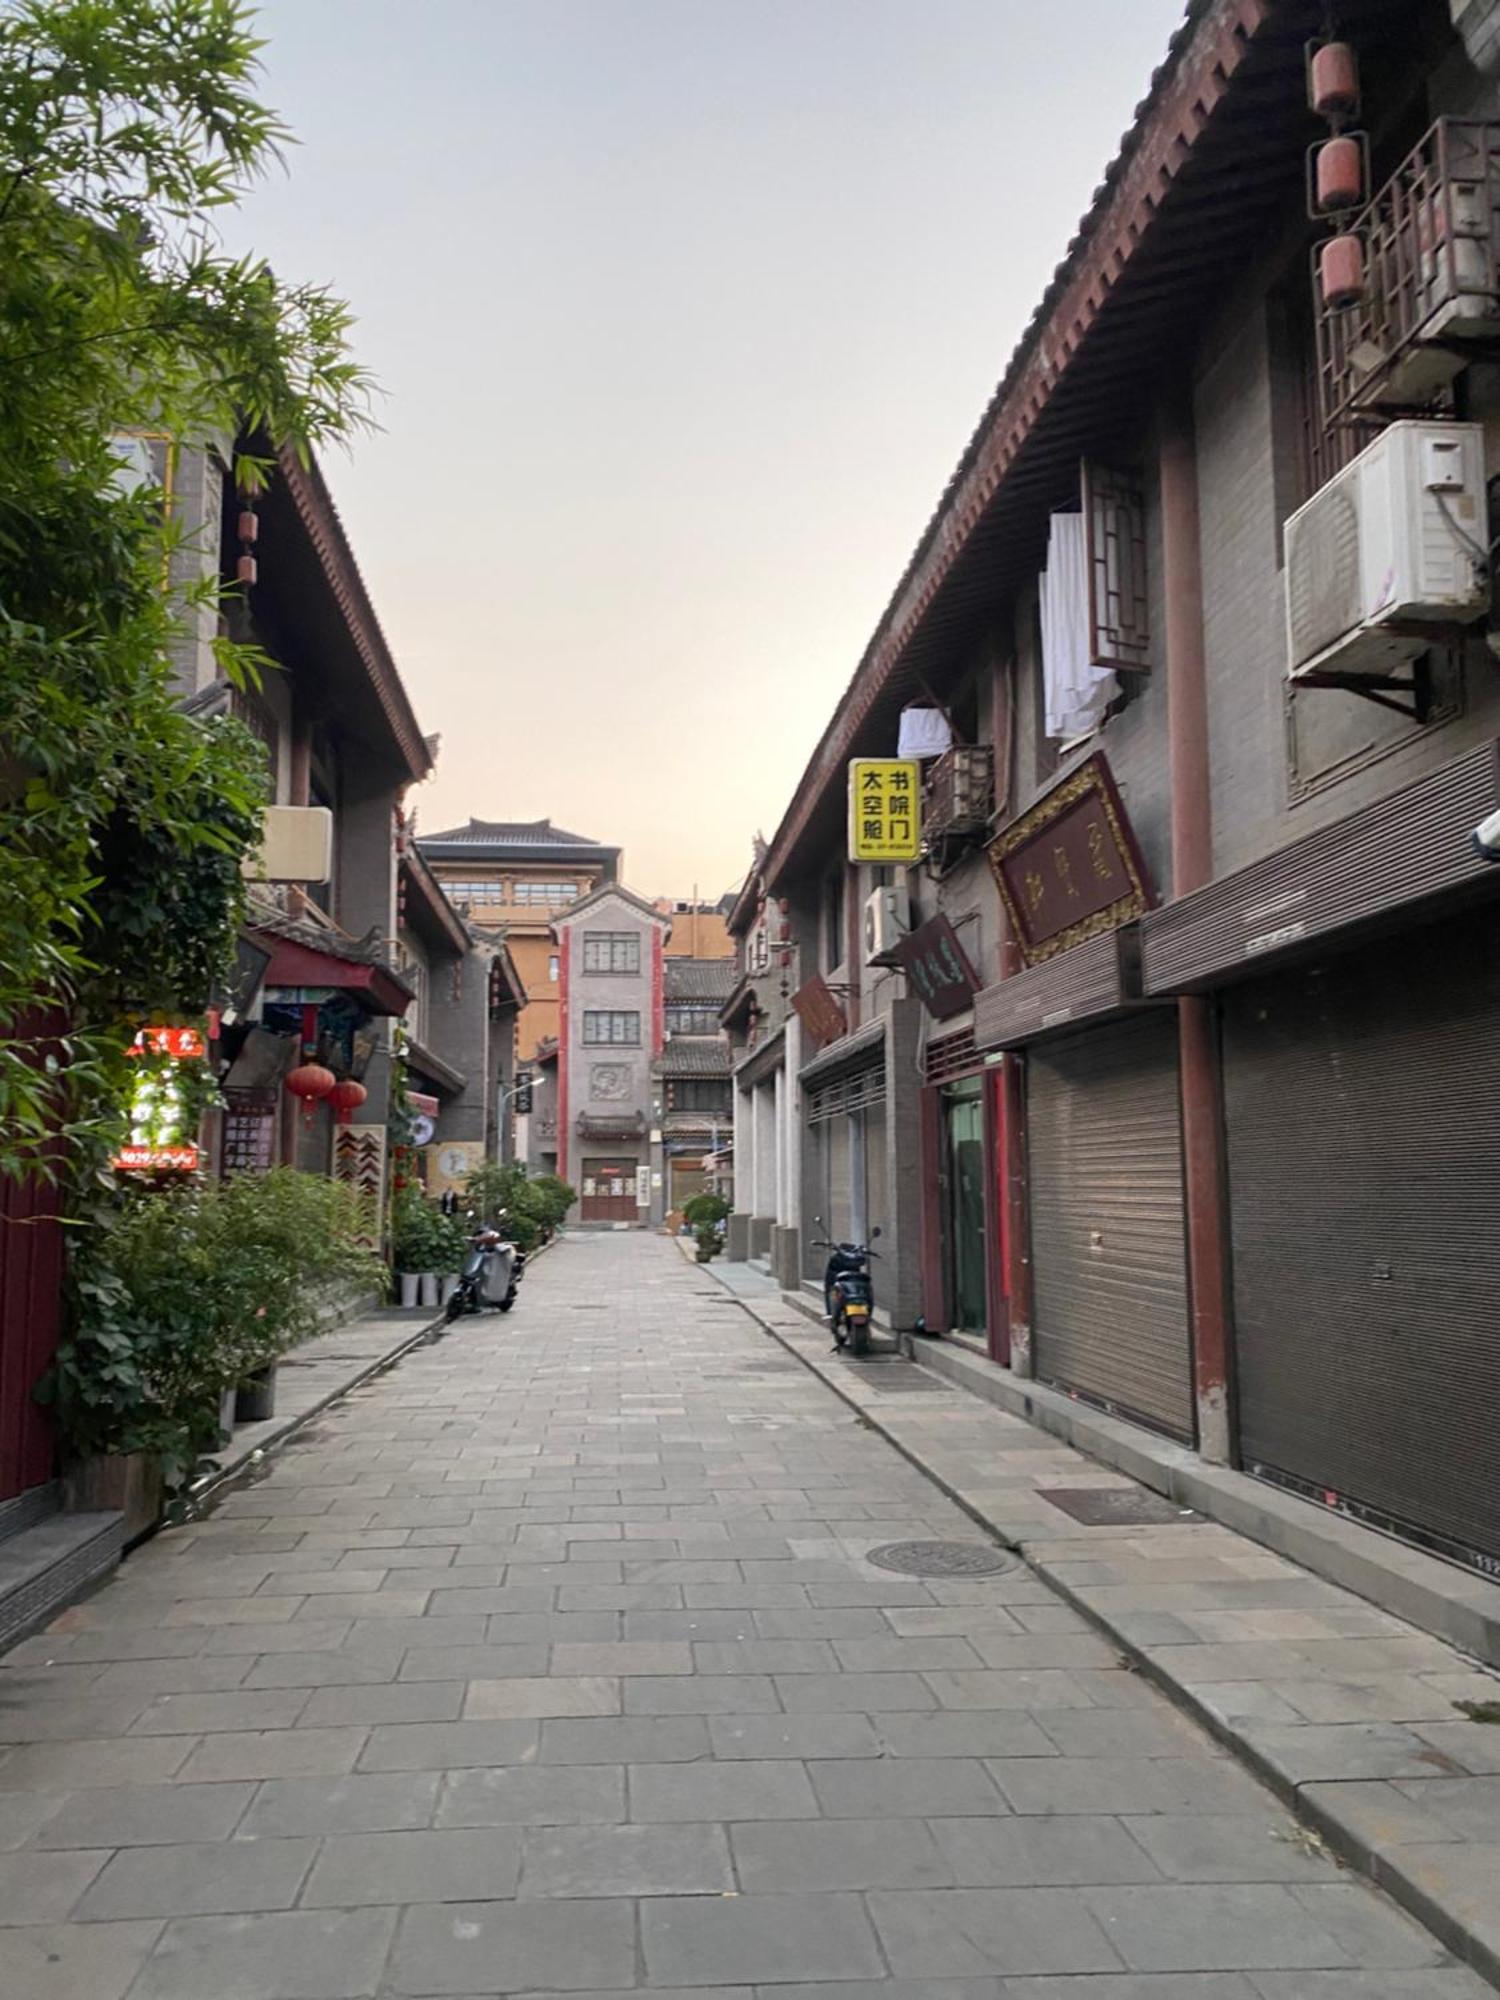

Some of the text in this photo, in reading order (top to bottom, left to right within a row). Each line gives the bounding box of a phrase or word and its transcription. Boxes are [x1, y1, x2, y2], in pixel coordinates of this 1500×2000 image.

[862, 771, 882, 840] 太空舱
[888, 771, 909, 840] 书院门
